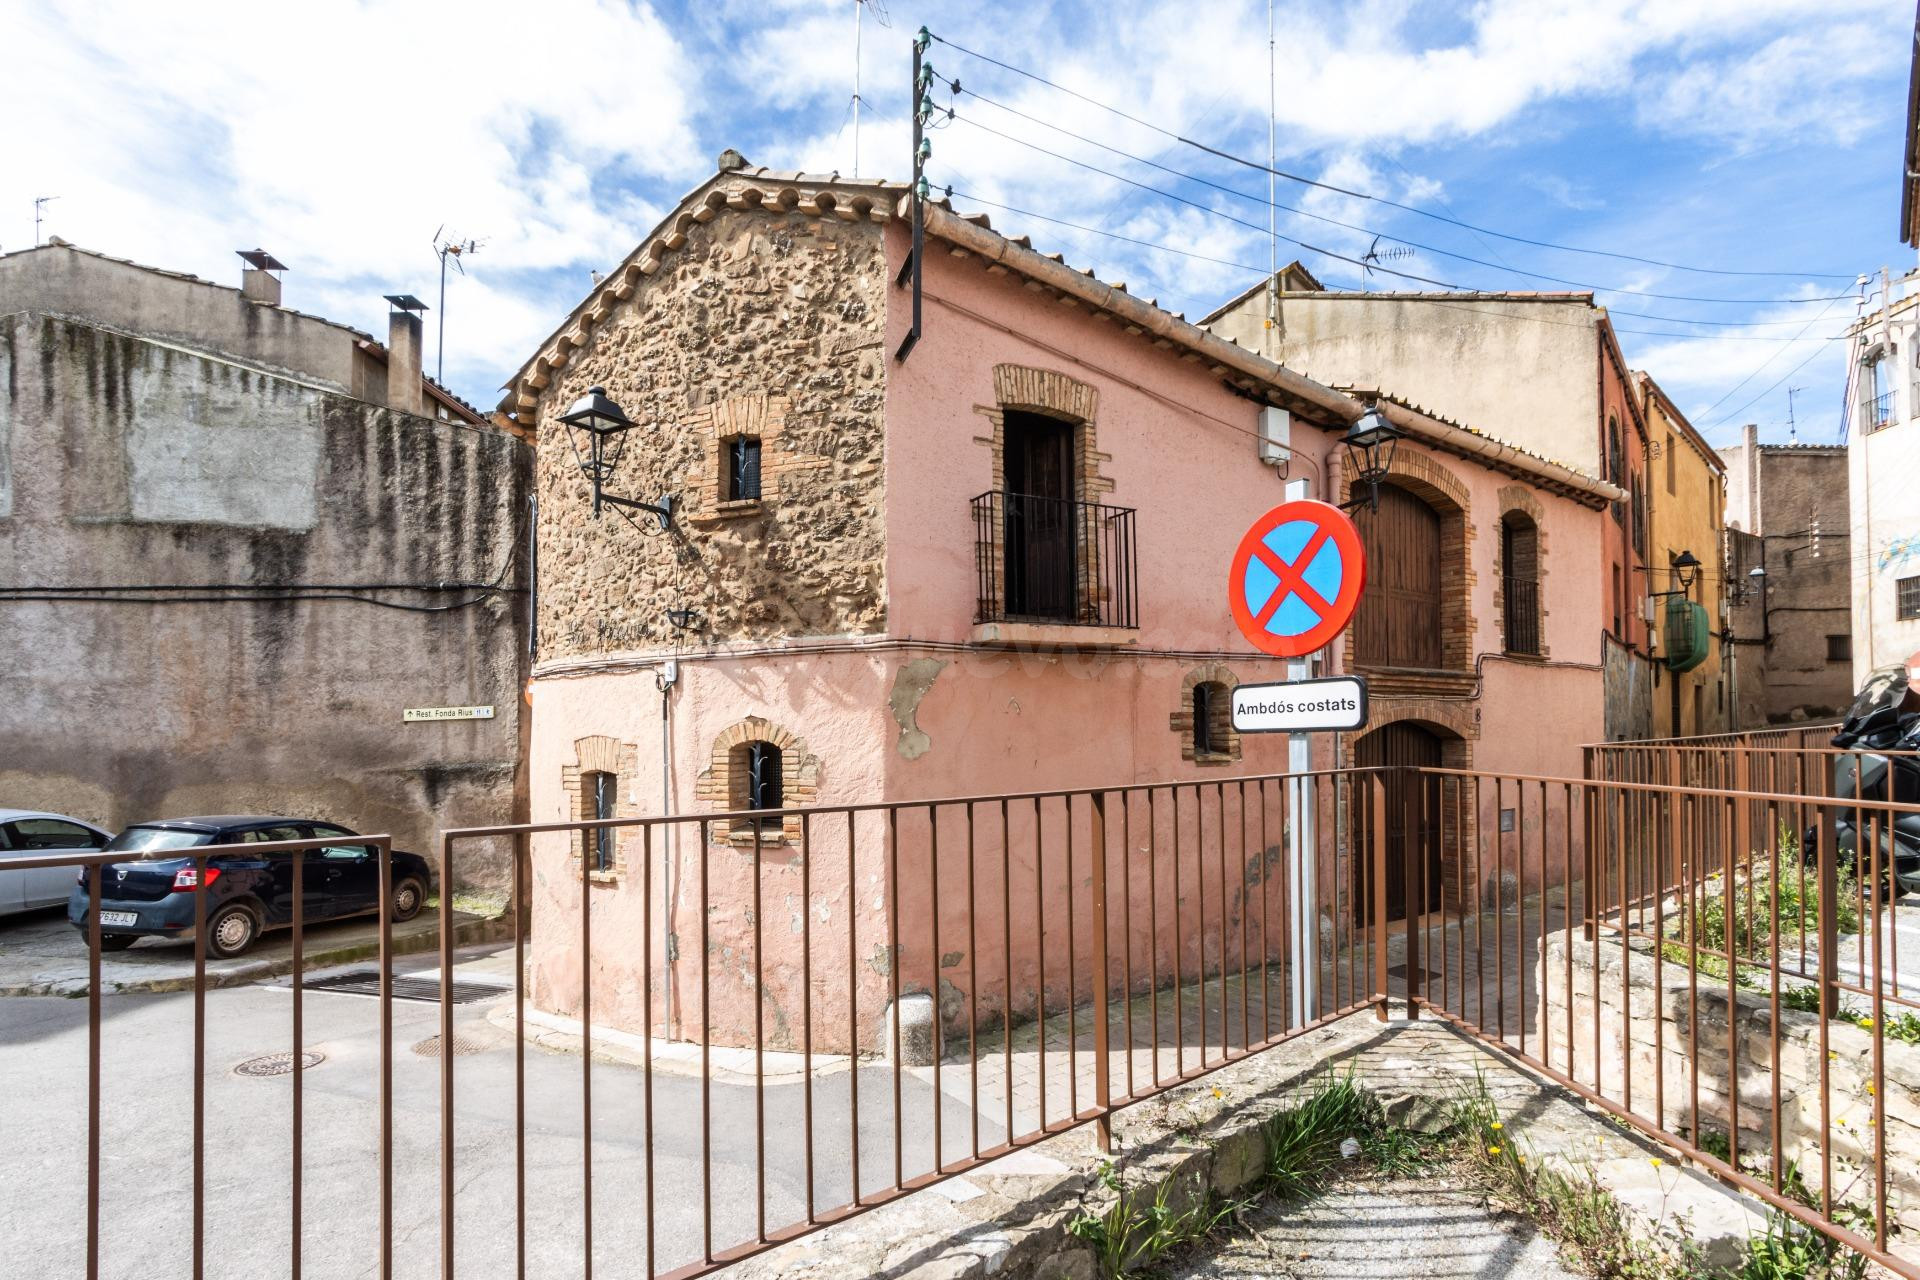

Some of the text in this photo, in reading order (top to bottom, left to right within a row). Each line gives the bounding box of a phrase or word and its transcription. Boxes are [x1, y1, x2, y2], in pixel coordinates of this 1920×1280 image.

[1237, 698, 1356, 716] Ambdós costats
[435, 709, 456, 717] Fonda
[458, 708, 473, 716] Rius
[120, 913, 136, 923] JLT
